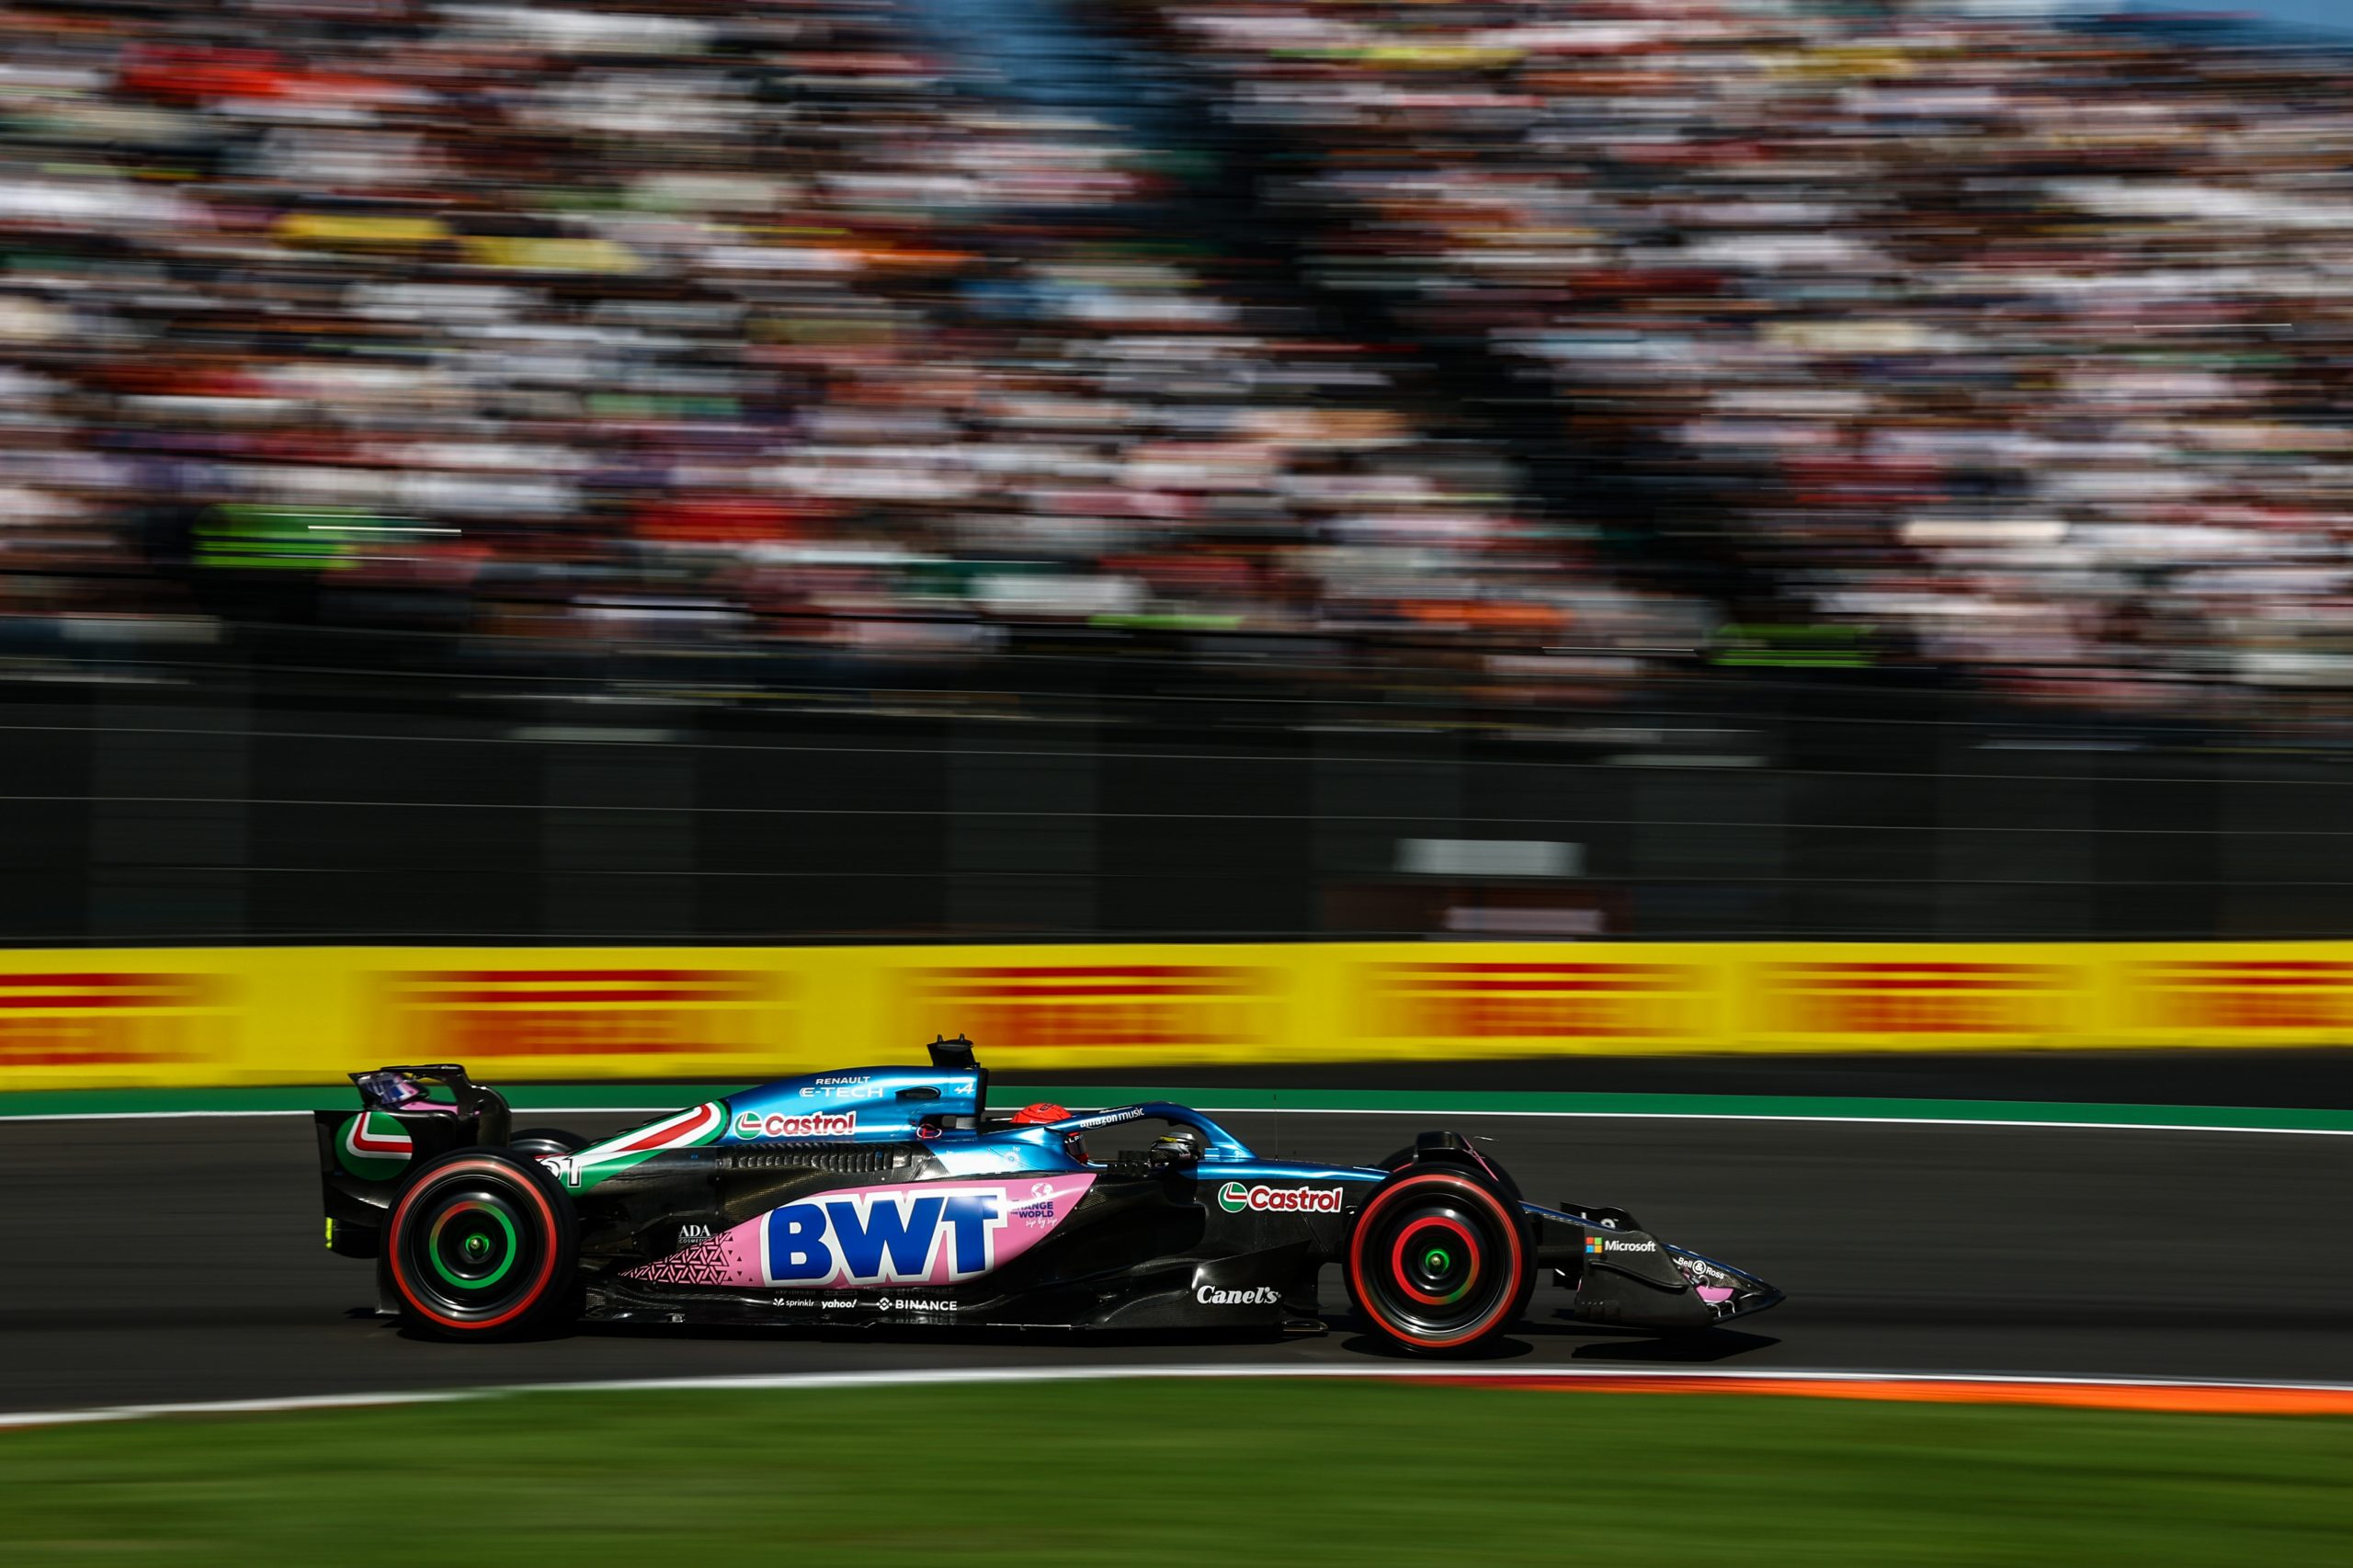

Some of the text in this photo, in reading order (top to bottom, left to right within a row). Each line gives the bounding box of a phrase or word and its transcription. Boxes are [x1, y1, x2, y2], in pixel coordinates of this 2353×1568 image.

[815, 1076, 870, 1085] RENAULT
[800, 1086, 883, 1098] E-TECH
[765, 1111, 856, 1136] Castrol
[1080, 1108, 1145, 1129] amazon music
[1013, 1200, 1054, 1210] ANGE
[1249, 1187, 1342, 1211] Castrol
[1019, 1210, 1054, 1219] WORLD
[678, 1224, 710, 1237] ADA
[764, 1191, 1002, 1283] BWT
[1604, 1240, 1656, 1252] Microsoft
[1677, 1256, 1693, 1268] Bell
[1706, 1267, 1725, 1279] Ross
[1196, 1285, 1279, 1304] Canel's
[786, 1299, 815, 1308] sprinklr
[822, 1299, 858, 1309] yahoo!
[894, 1299, 958, 1311] BINANCE
